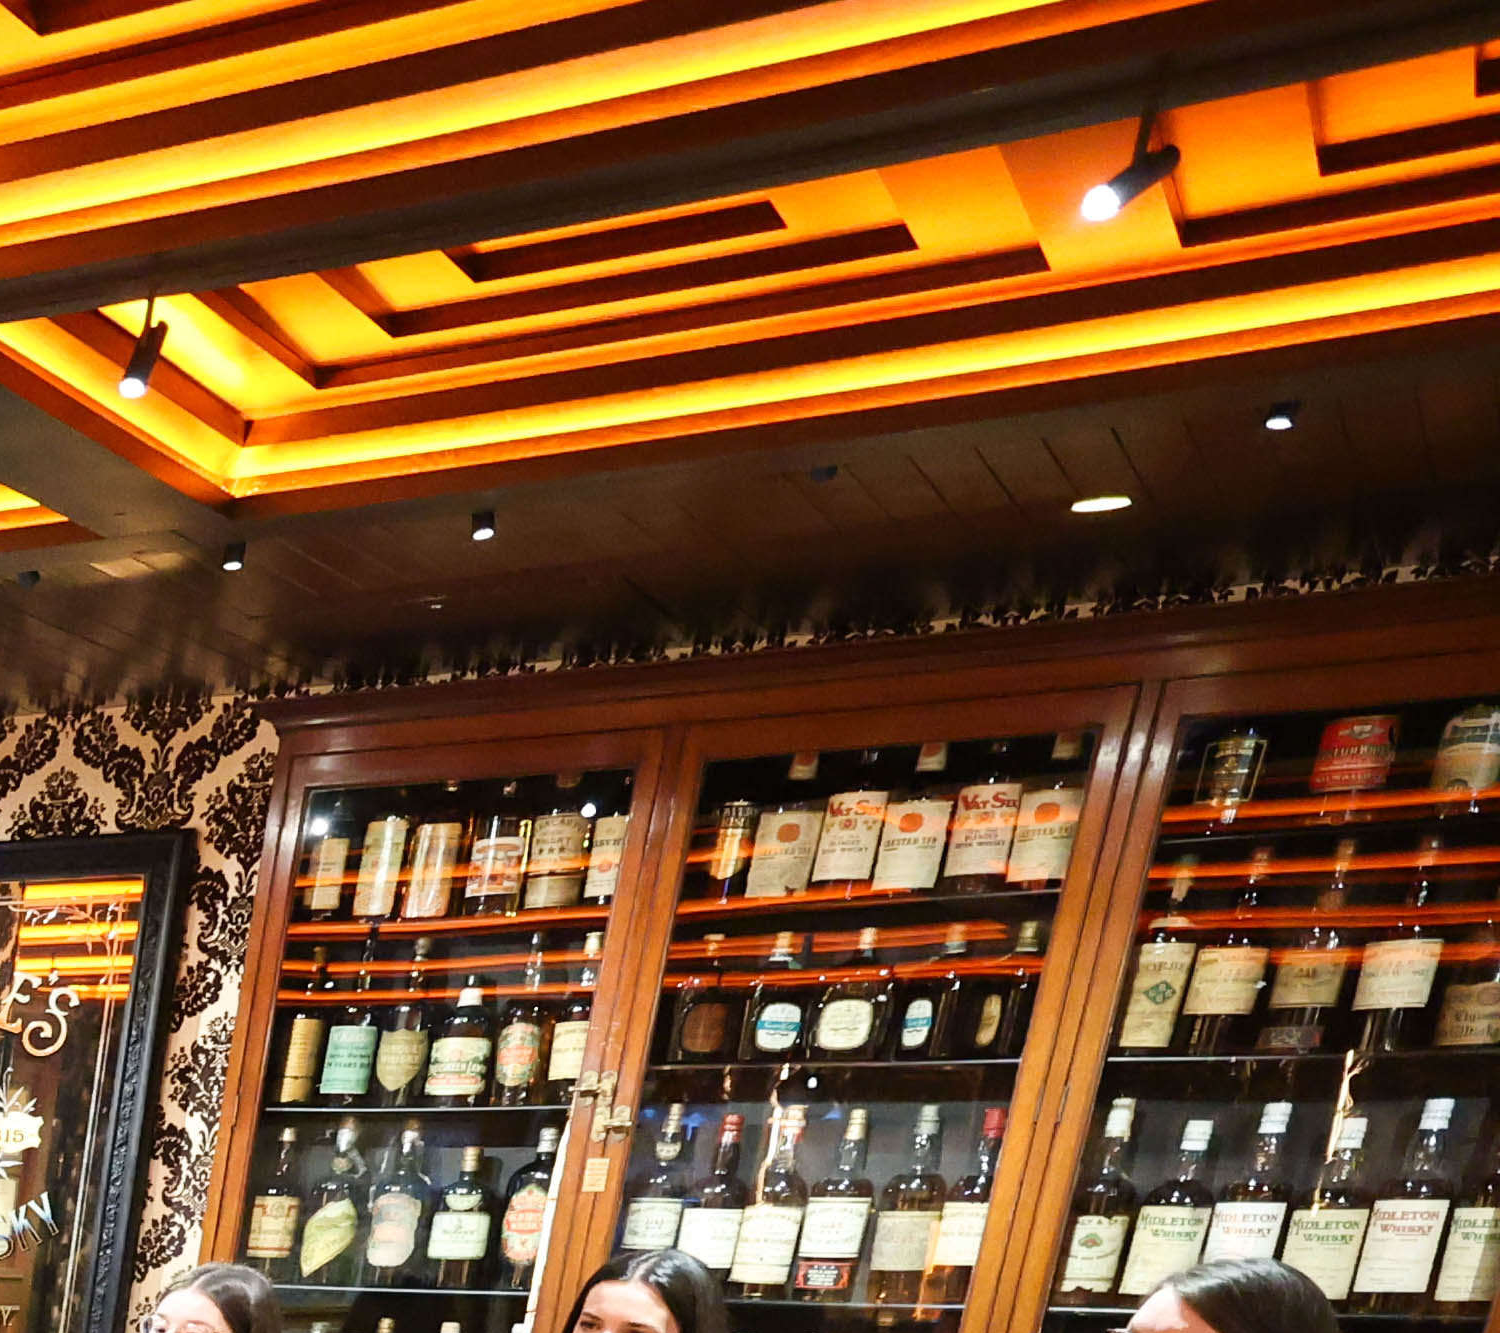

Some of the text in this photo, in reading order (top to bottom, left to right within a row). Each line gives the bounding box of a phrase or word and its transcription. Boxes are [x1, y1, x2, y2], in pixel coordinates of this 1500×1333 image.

[1139, 1212, 1205, 1230] MIDLETON
[1214, 1211, 1278, 1228] MIDLETON
[1372, 1207, 1440, 1227] MIDLETON
[1451, 1216, 1500, 1234] MIDLET
[1290, 1217, 1360, 1236] MIDLETON
